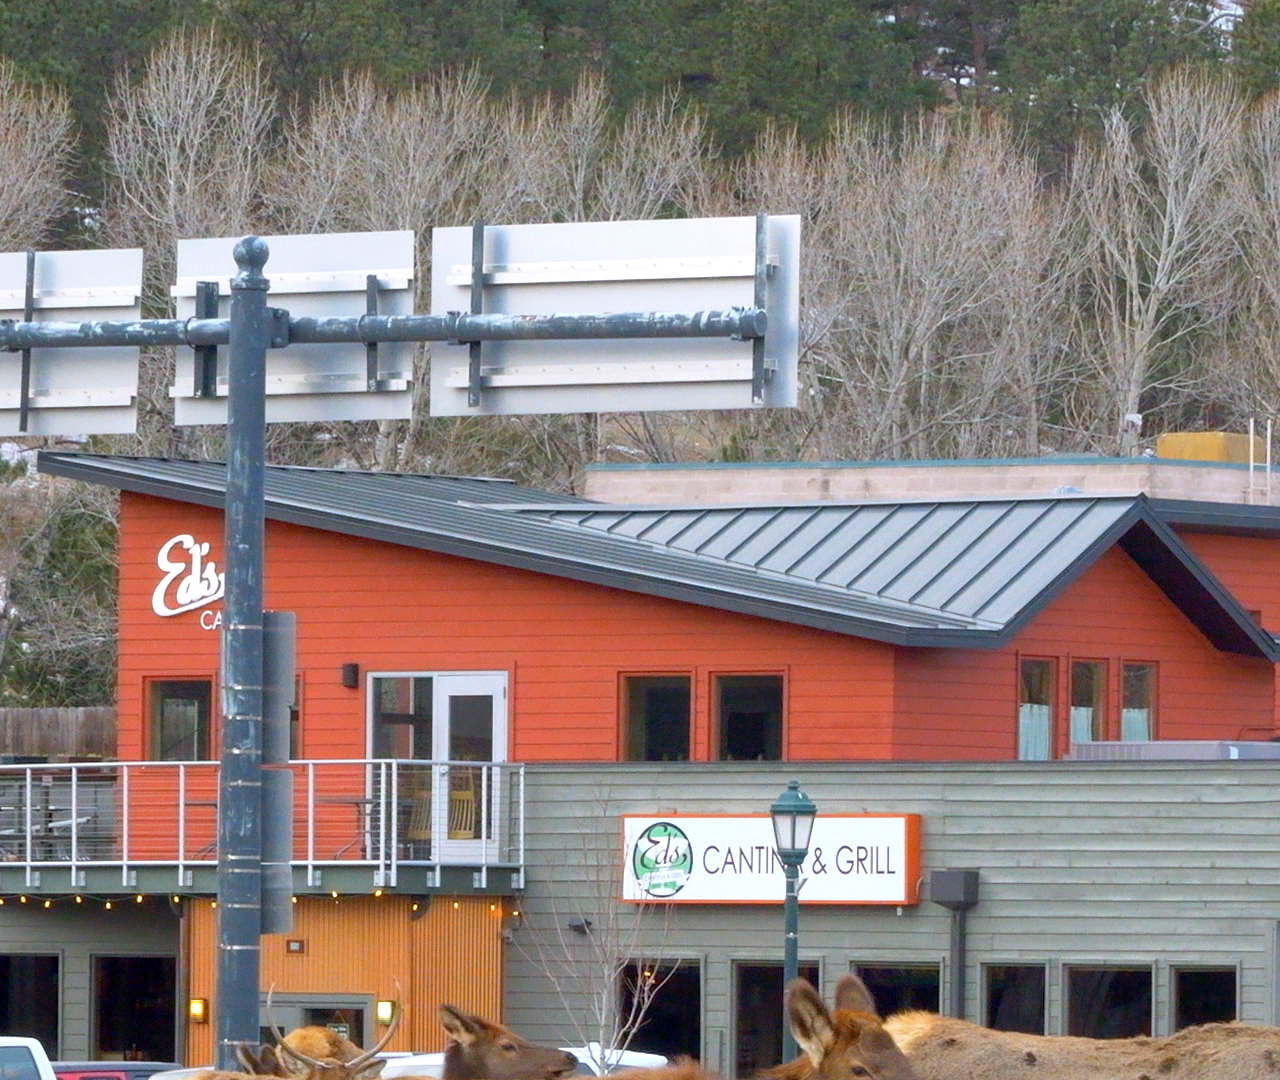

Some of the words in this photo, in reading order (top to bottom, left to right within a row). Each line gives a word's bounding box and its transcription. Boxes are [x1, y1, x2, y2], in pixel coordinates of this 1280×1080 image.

[640, 824, 688, 870] Ed's
[812, 846, 828, 875] &
[835, 845, 896, 875] GRILL
